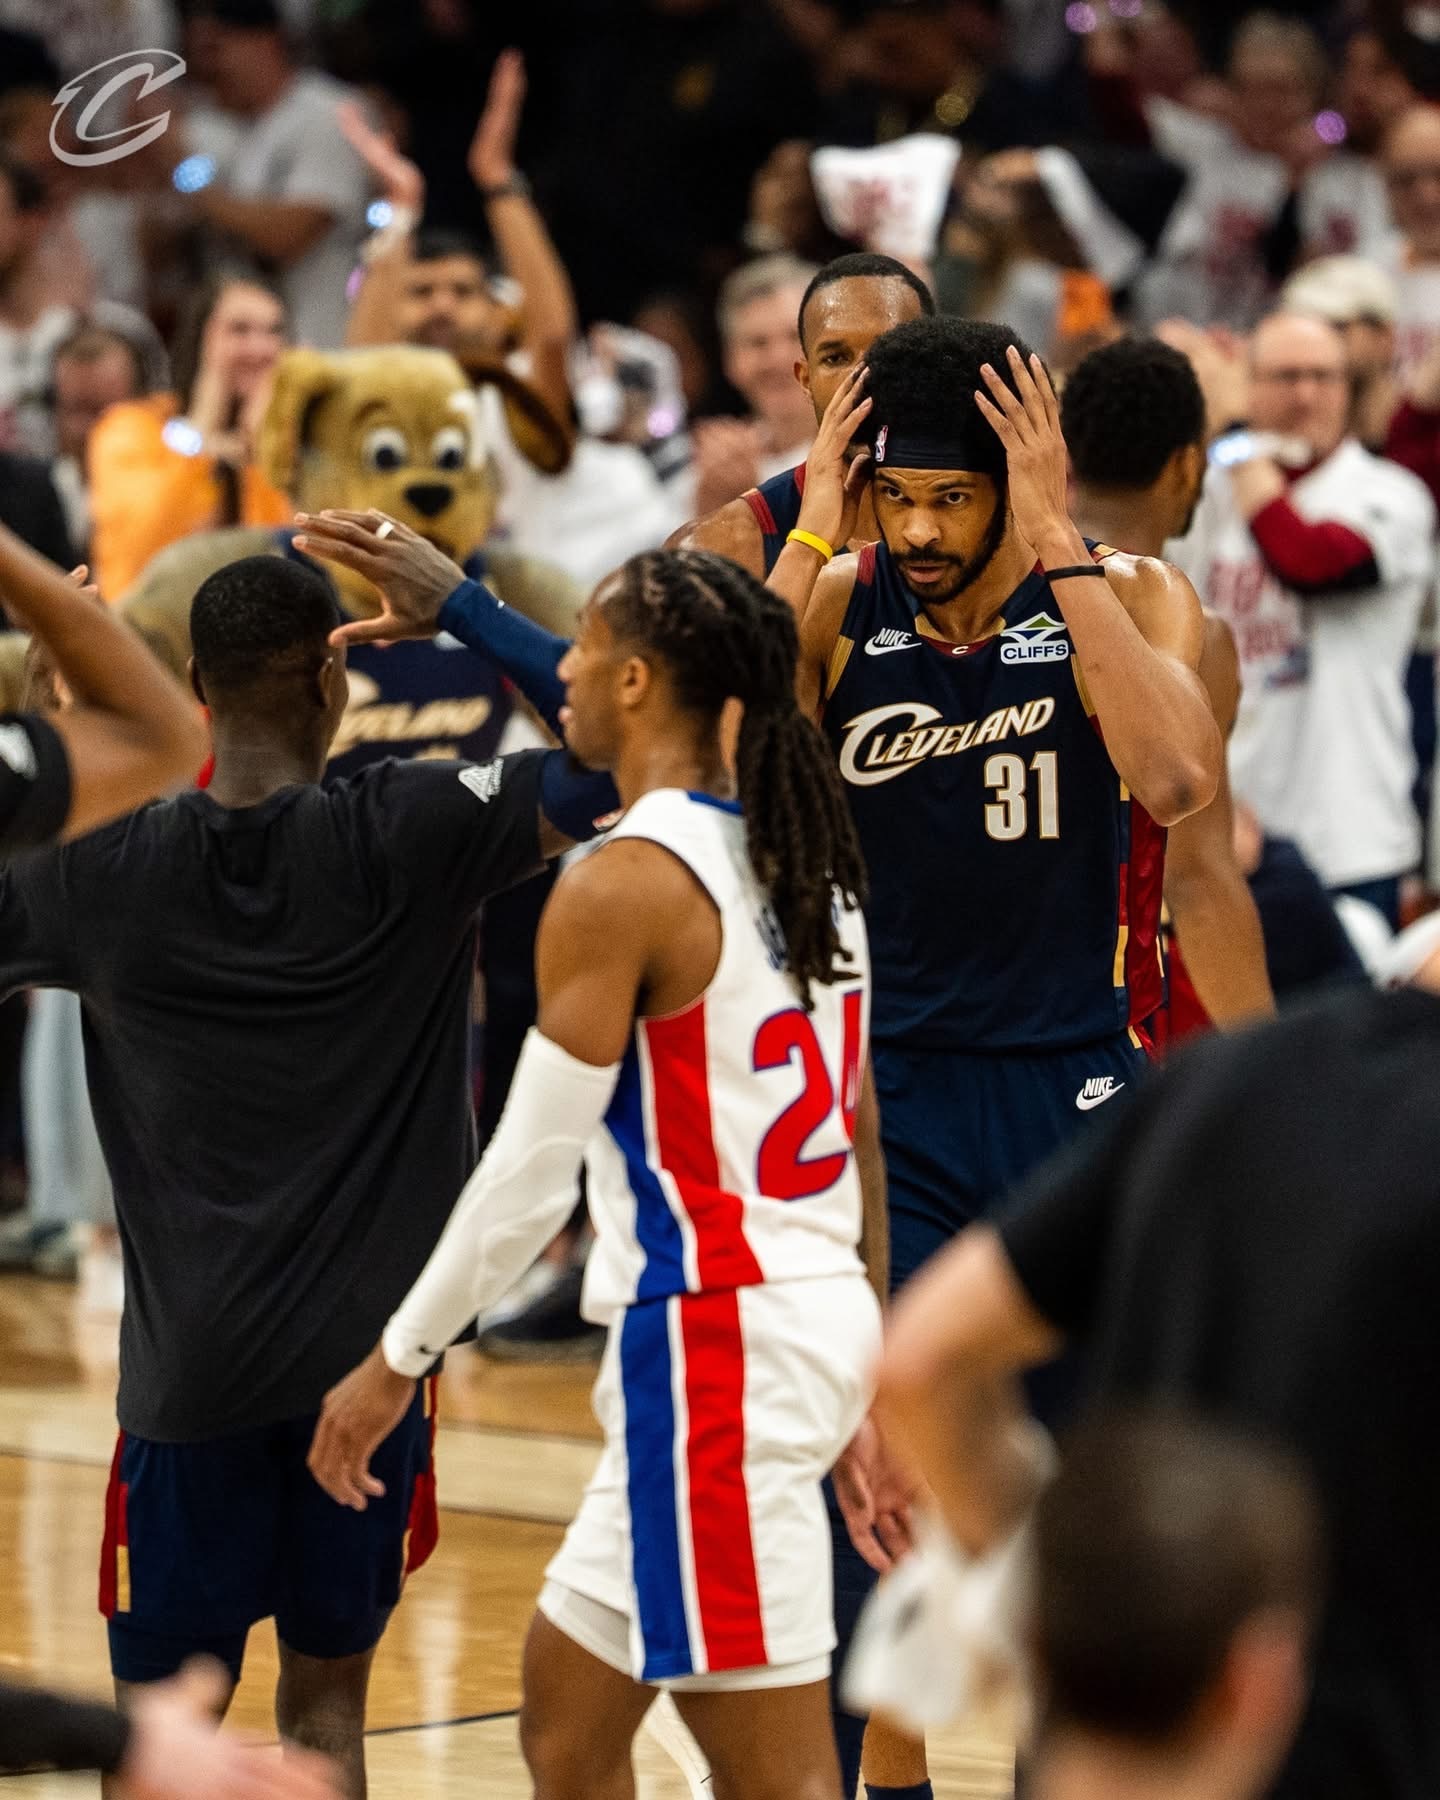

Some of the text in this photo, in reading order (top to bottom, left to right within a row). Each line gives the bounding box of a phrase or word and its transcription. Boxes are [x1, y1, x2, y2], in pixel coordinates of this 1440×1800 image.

[874, 627, 912, 648] NIKE
[1003, 643, 1067, 660] CLIFFS
[839, 696, 1055, 786] CLEVELAND
[984, 750, 1060, 841] 31
[1083, 1076, 1115, 1097] NIKE
